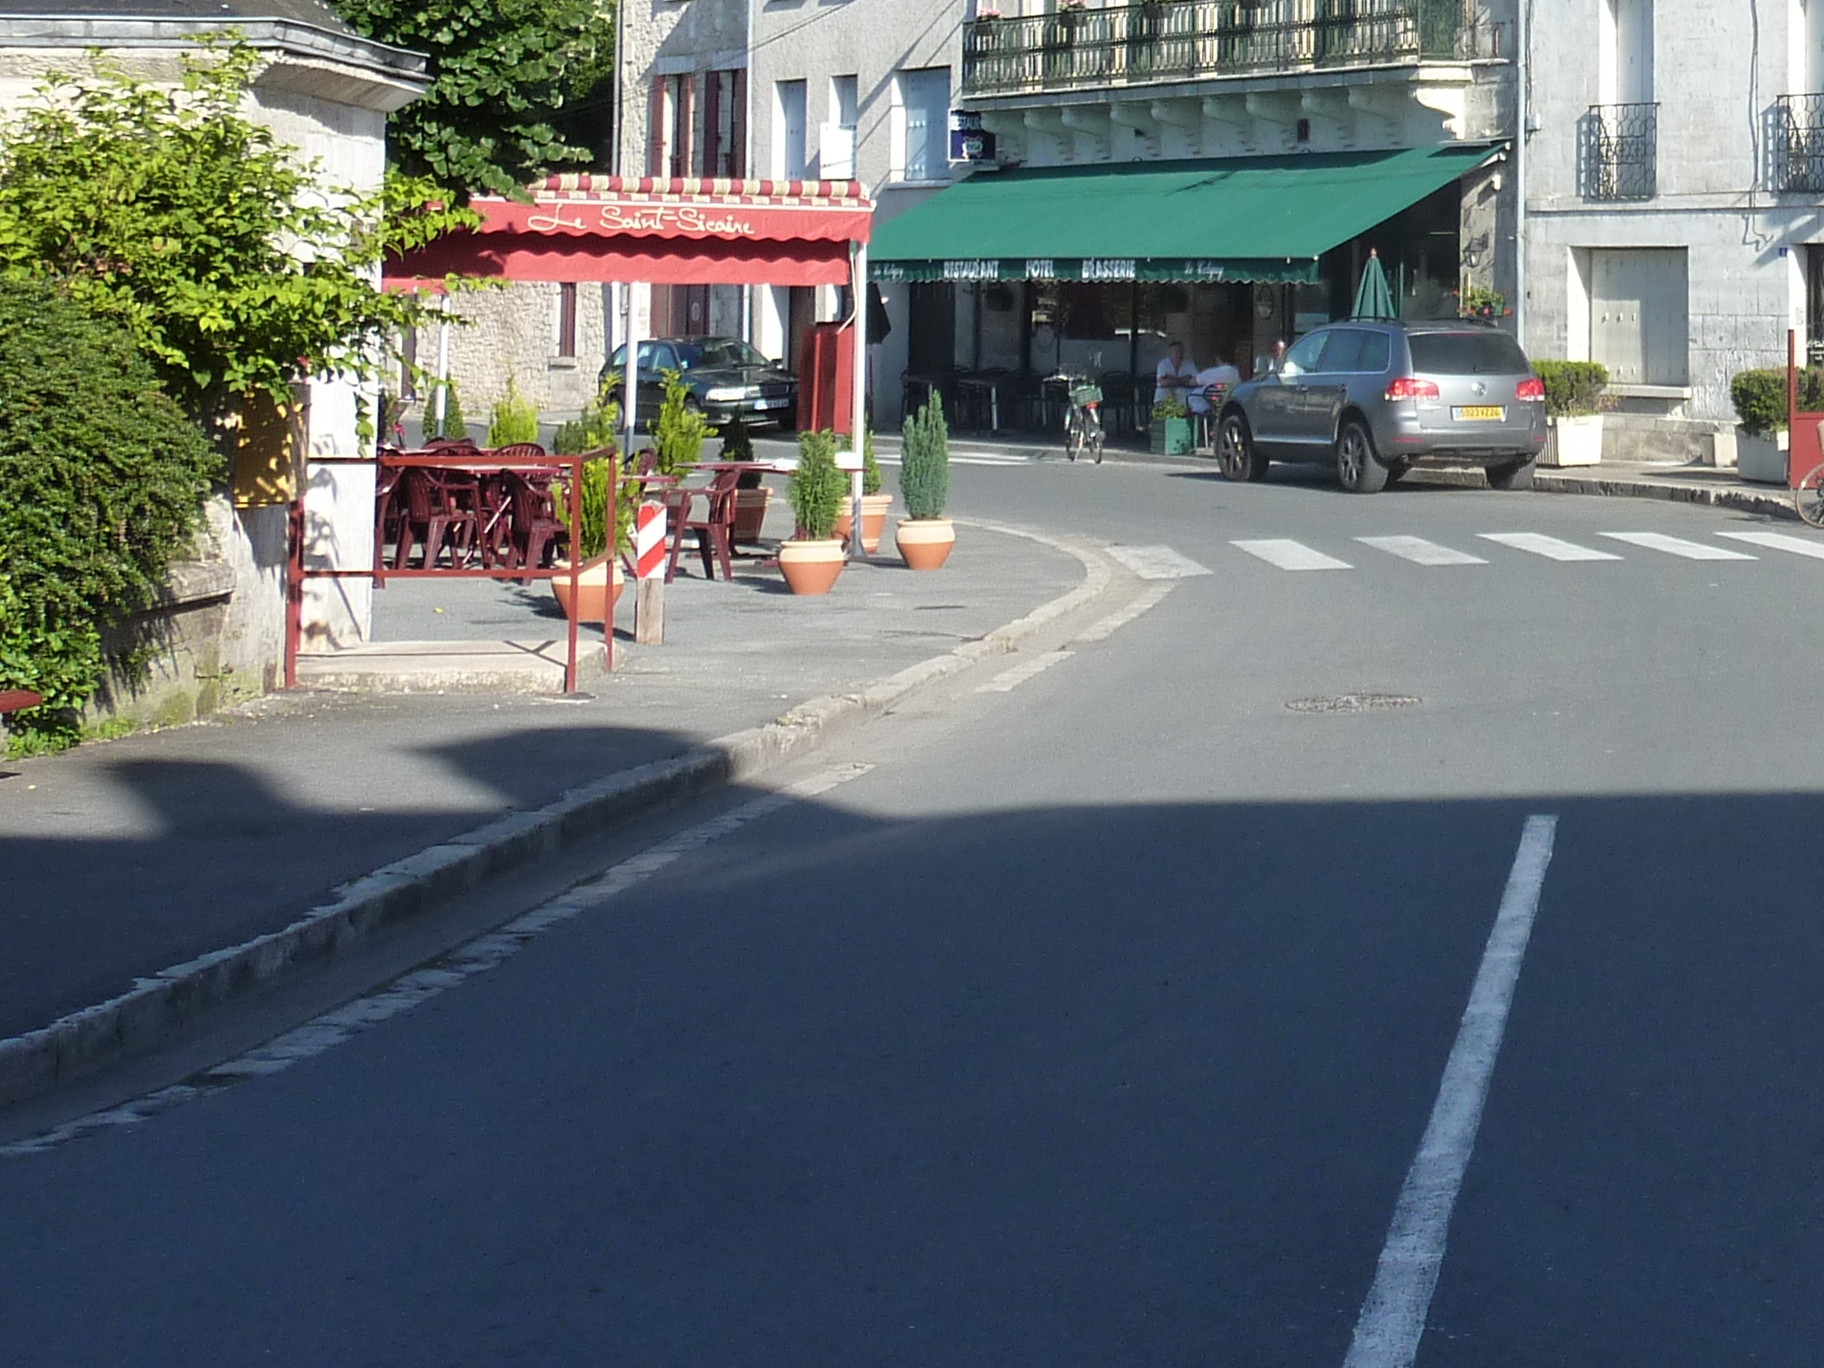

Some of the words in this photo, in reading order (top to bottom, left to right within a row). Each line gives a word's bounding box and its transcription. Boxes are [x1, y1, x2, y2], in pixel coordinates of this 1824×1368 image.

[527, 203, 588, 231] Le
[599, 206, 756, 235] Saint-Sicaire
[943, 259, 1000, 279] RESTAURANT
[1025, 259, 1055, 278] HOTEL
[1081, 258, 1136, 279] BRASSERIE
